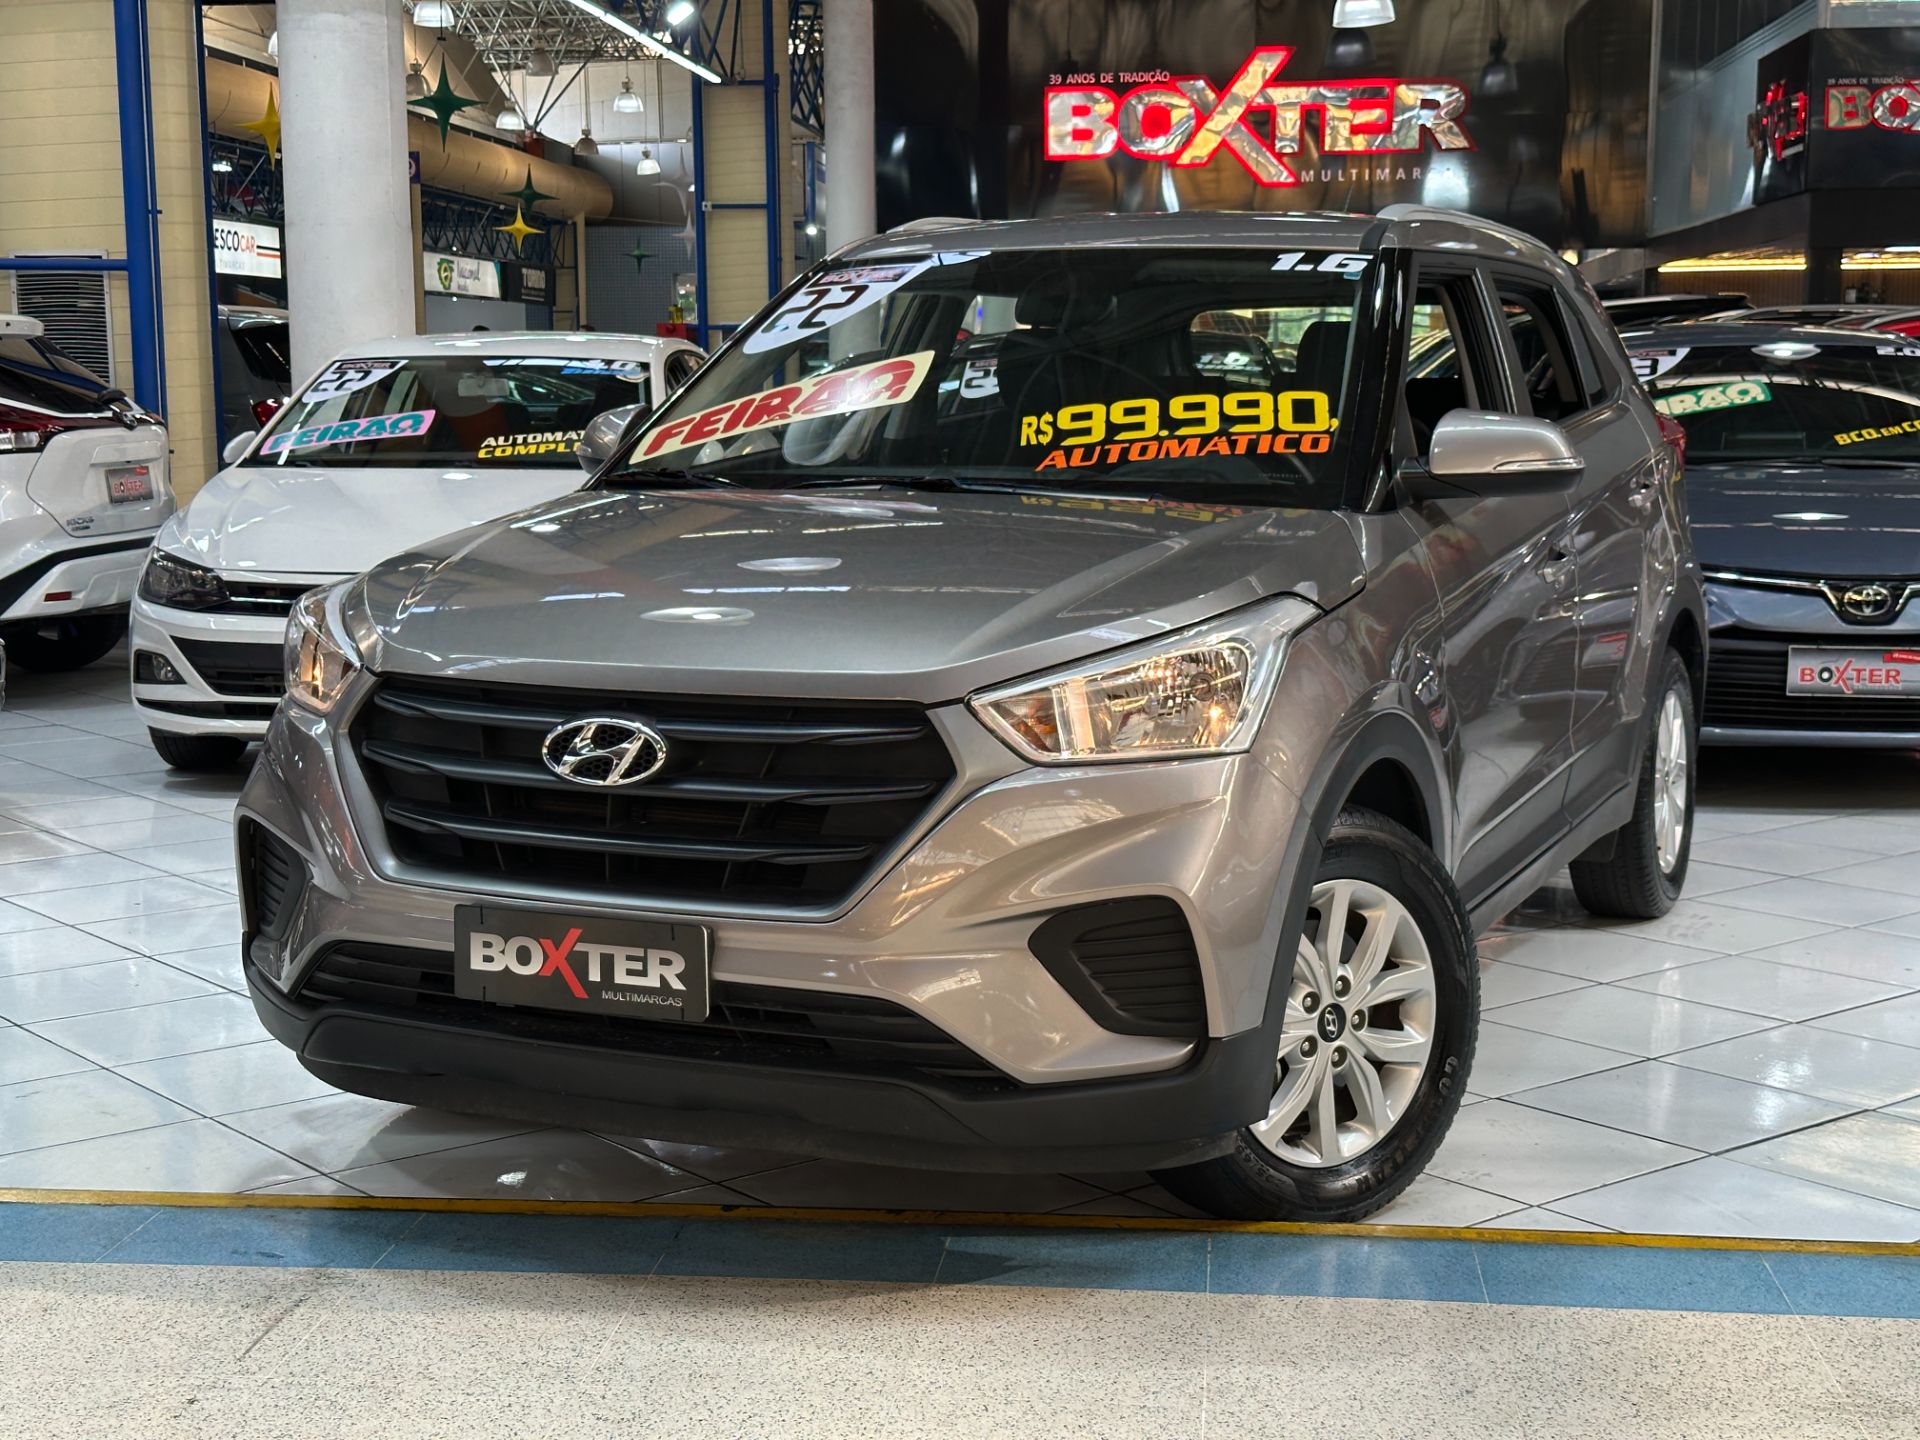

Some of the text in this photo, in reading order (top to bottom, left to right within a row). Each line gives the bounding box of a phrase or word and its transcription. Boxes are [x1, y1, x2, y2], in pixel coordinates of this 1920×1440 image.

[1049, 69, 1170, 85] 39 ANOS DE TRADIÇÃO
[1046, 47, 1474, 187] BOXTER
[1271, 252, 1374, 272] 1.6
[761, 284, 869, 334] 22
[310, 370, 372, 393] 22
[643, 360, 915, 456] FEIRÃO
[269, 413, 425, 450] FEIRÃO
[1035, 434, 1331, 472] AUTOMÁTICO
[1799, 659, 1901, 694] BOXTER
[470, 928, 687, 998] BOXTER
[602, 990, 683, 1007] MULTIMARCAS
